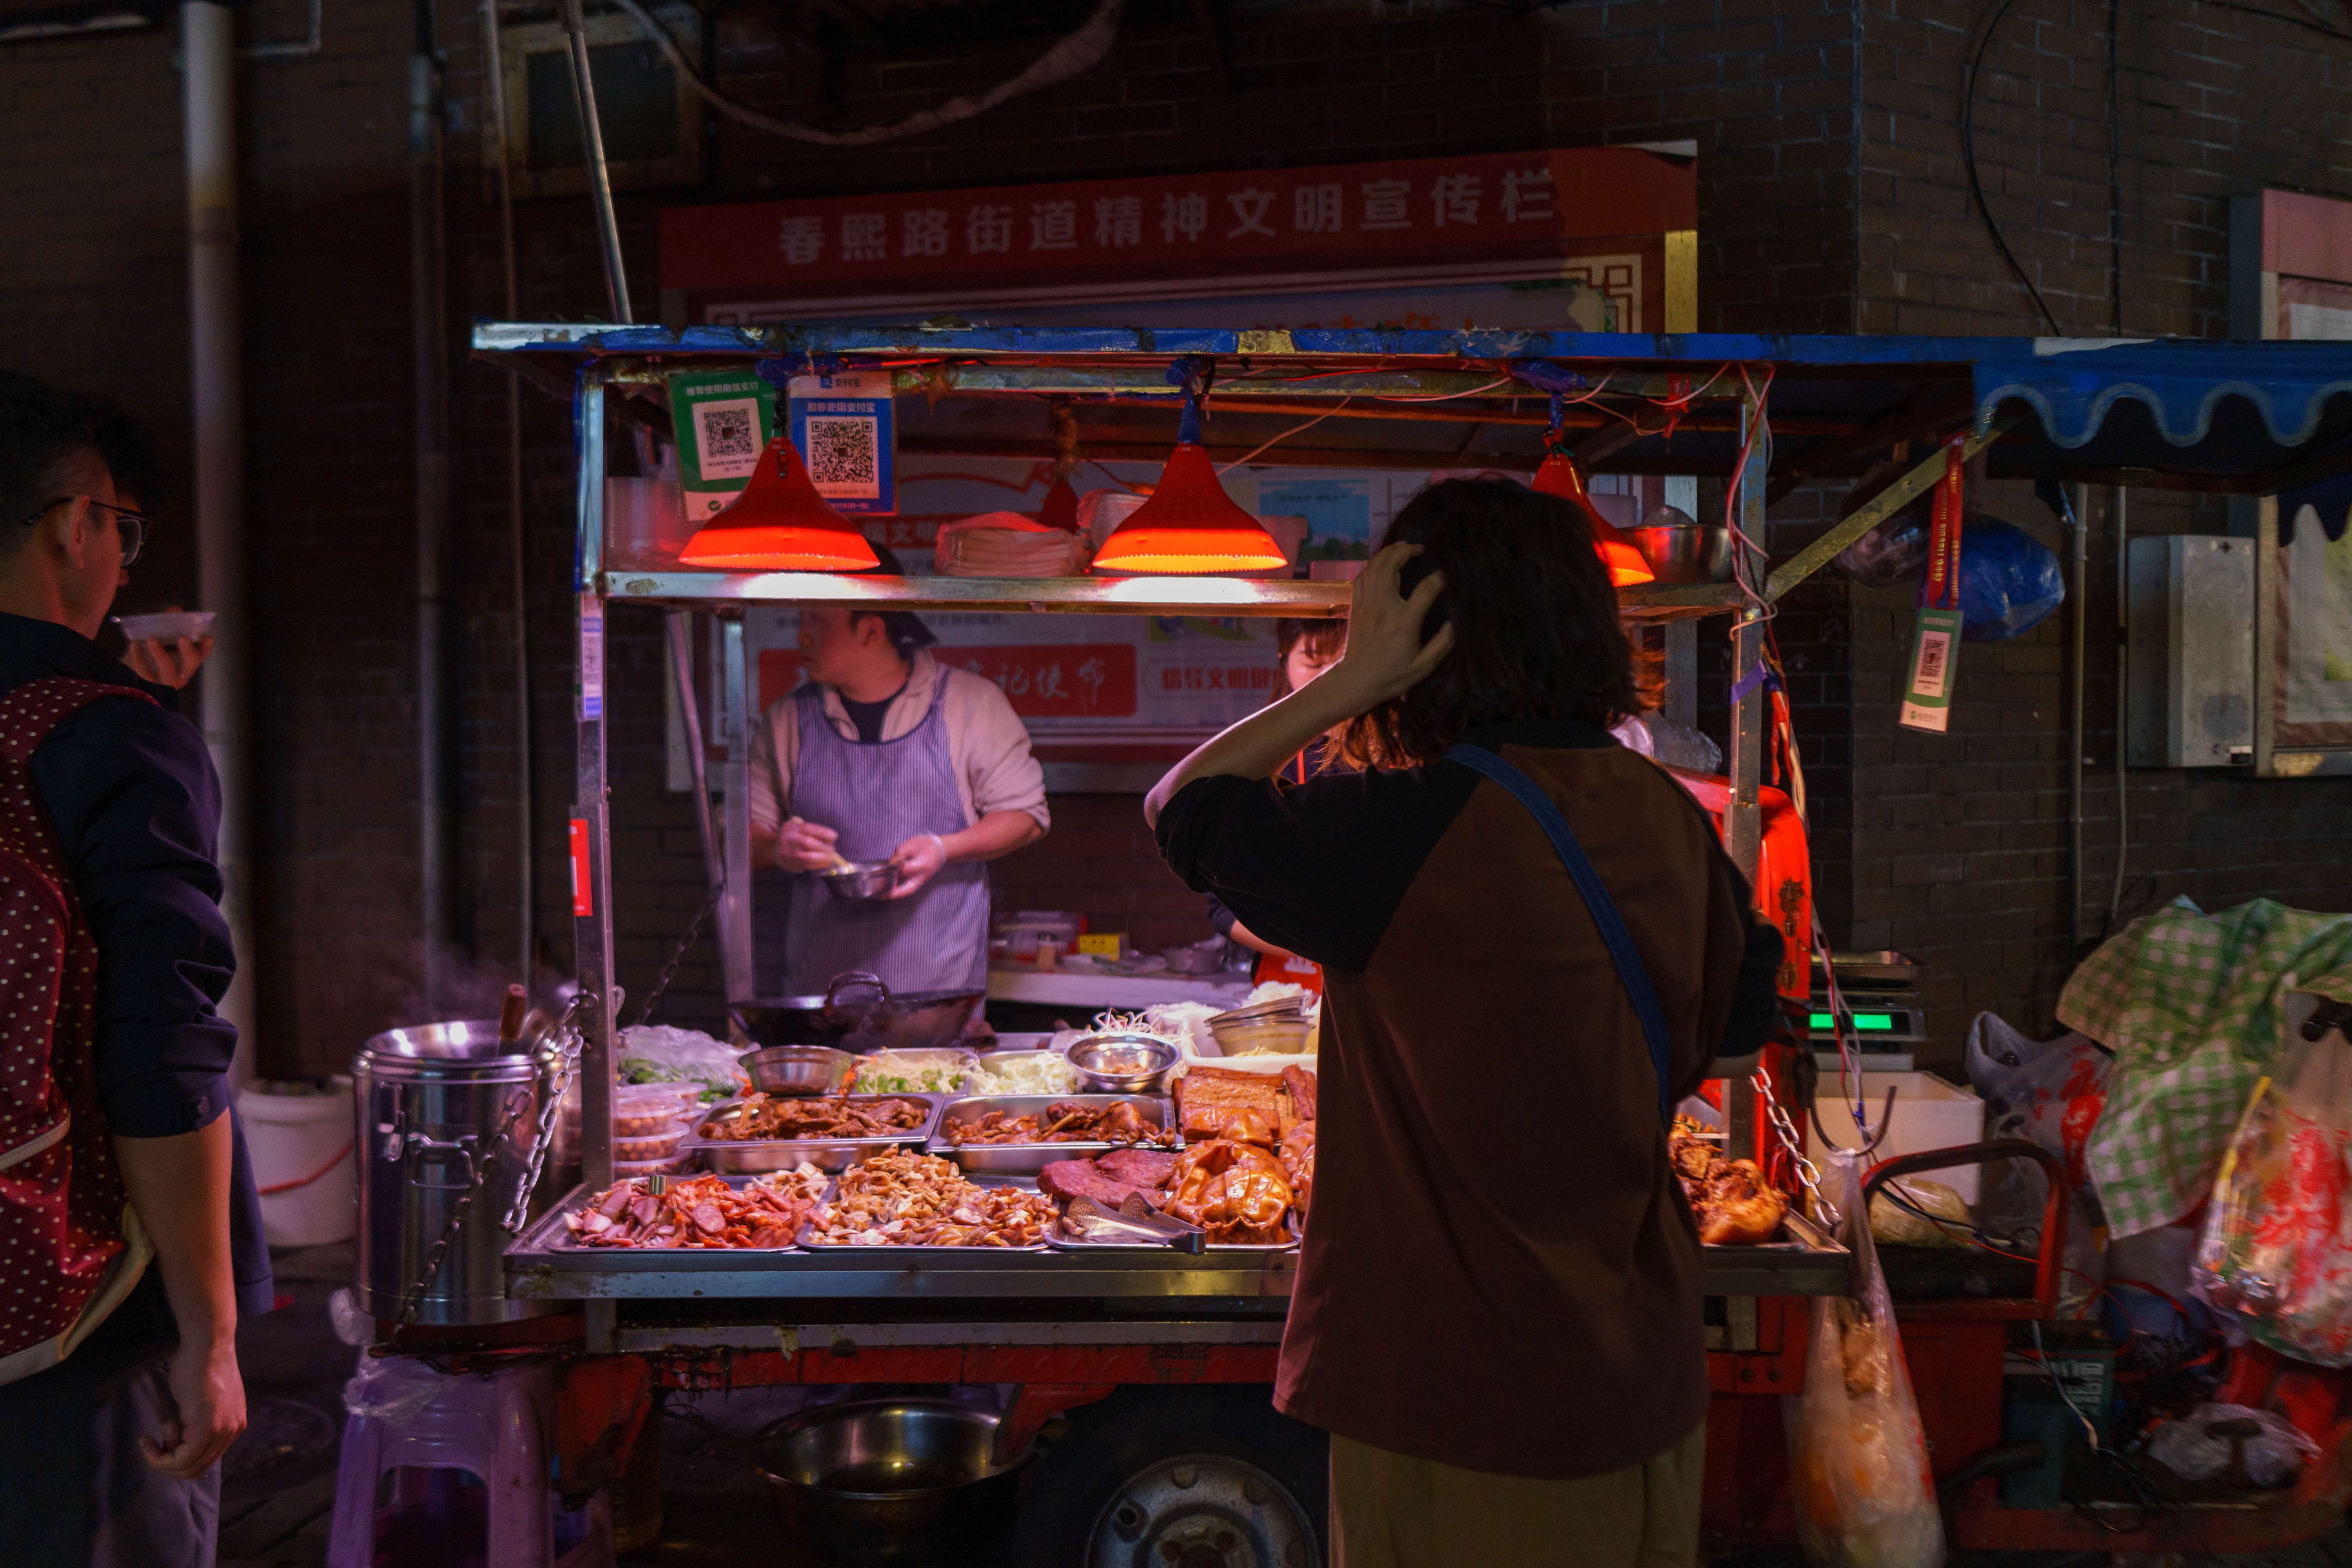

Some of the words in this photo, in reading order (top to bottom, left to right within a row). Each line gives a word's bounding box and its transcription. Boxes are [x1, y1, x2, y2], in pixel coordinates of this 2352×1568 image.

[780, 169, 1555, 265] 春熙路街道精神文明宣传栏
[686, 381, 758, 397] 推荐使用微信支付
[835, 378, 861, 387] 支付宝
[807, 402, 875, 413] 推荐使用支付宝
